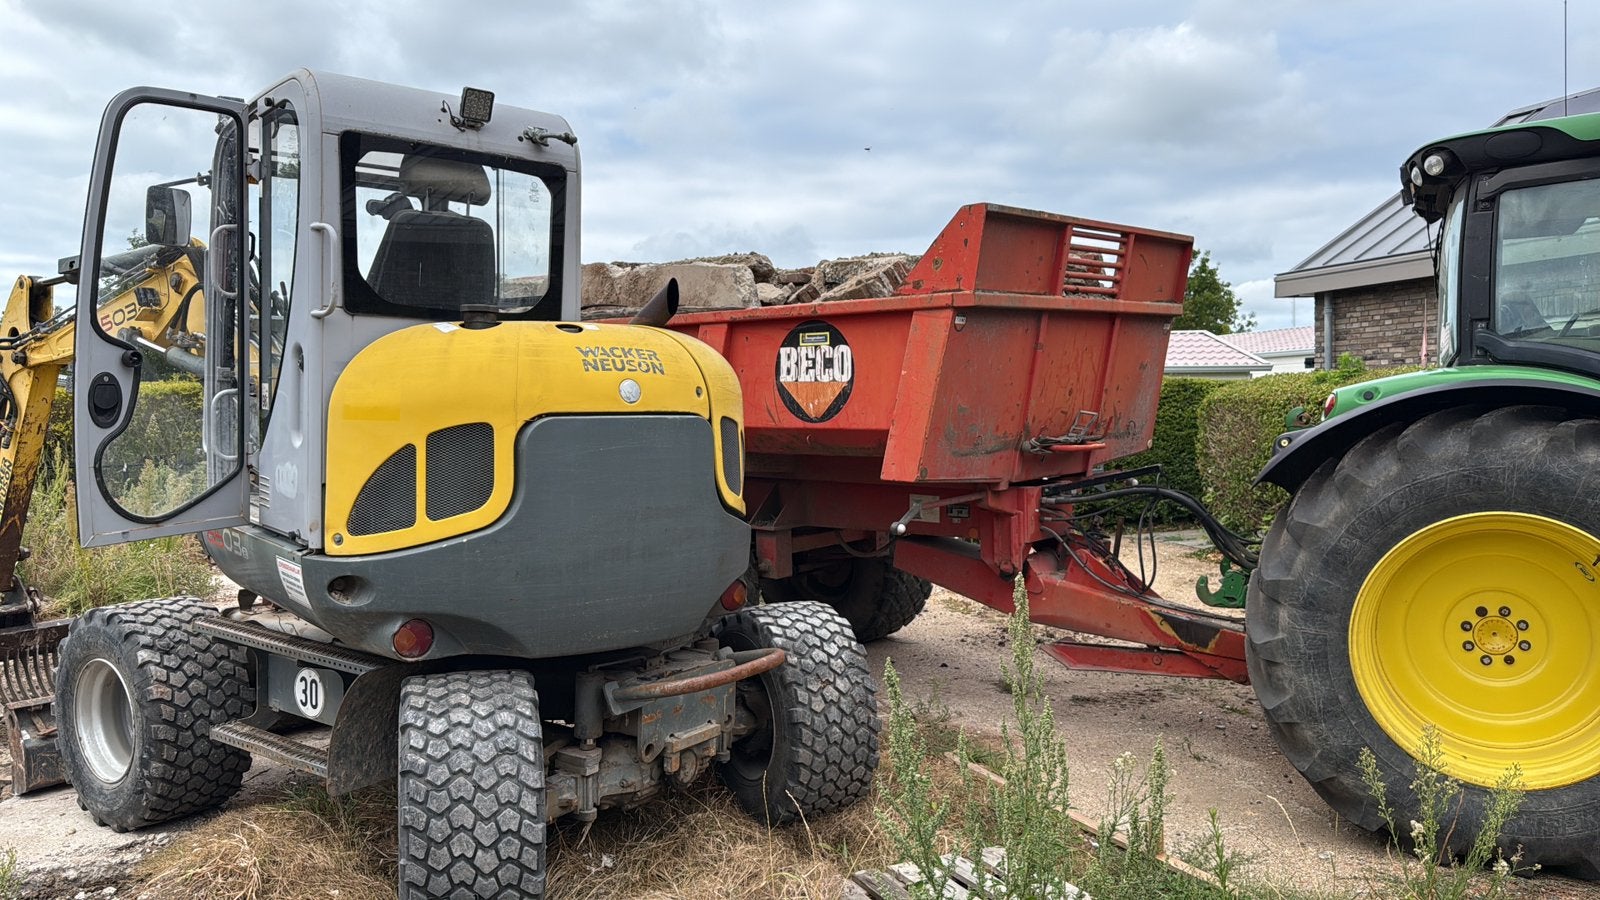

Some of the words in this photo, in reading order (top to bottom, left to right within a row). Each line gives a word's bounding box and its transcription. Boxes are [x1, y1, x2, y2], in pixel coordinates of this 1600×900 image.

[575, 346, 661, 362] WACKER
[581, 358, 665, 375] NEUSON
[780, 344, 852, 382] BECO
[300, 676, 318, 710] 30
